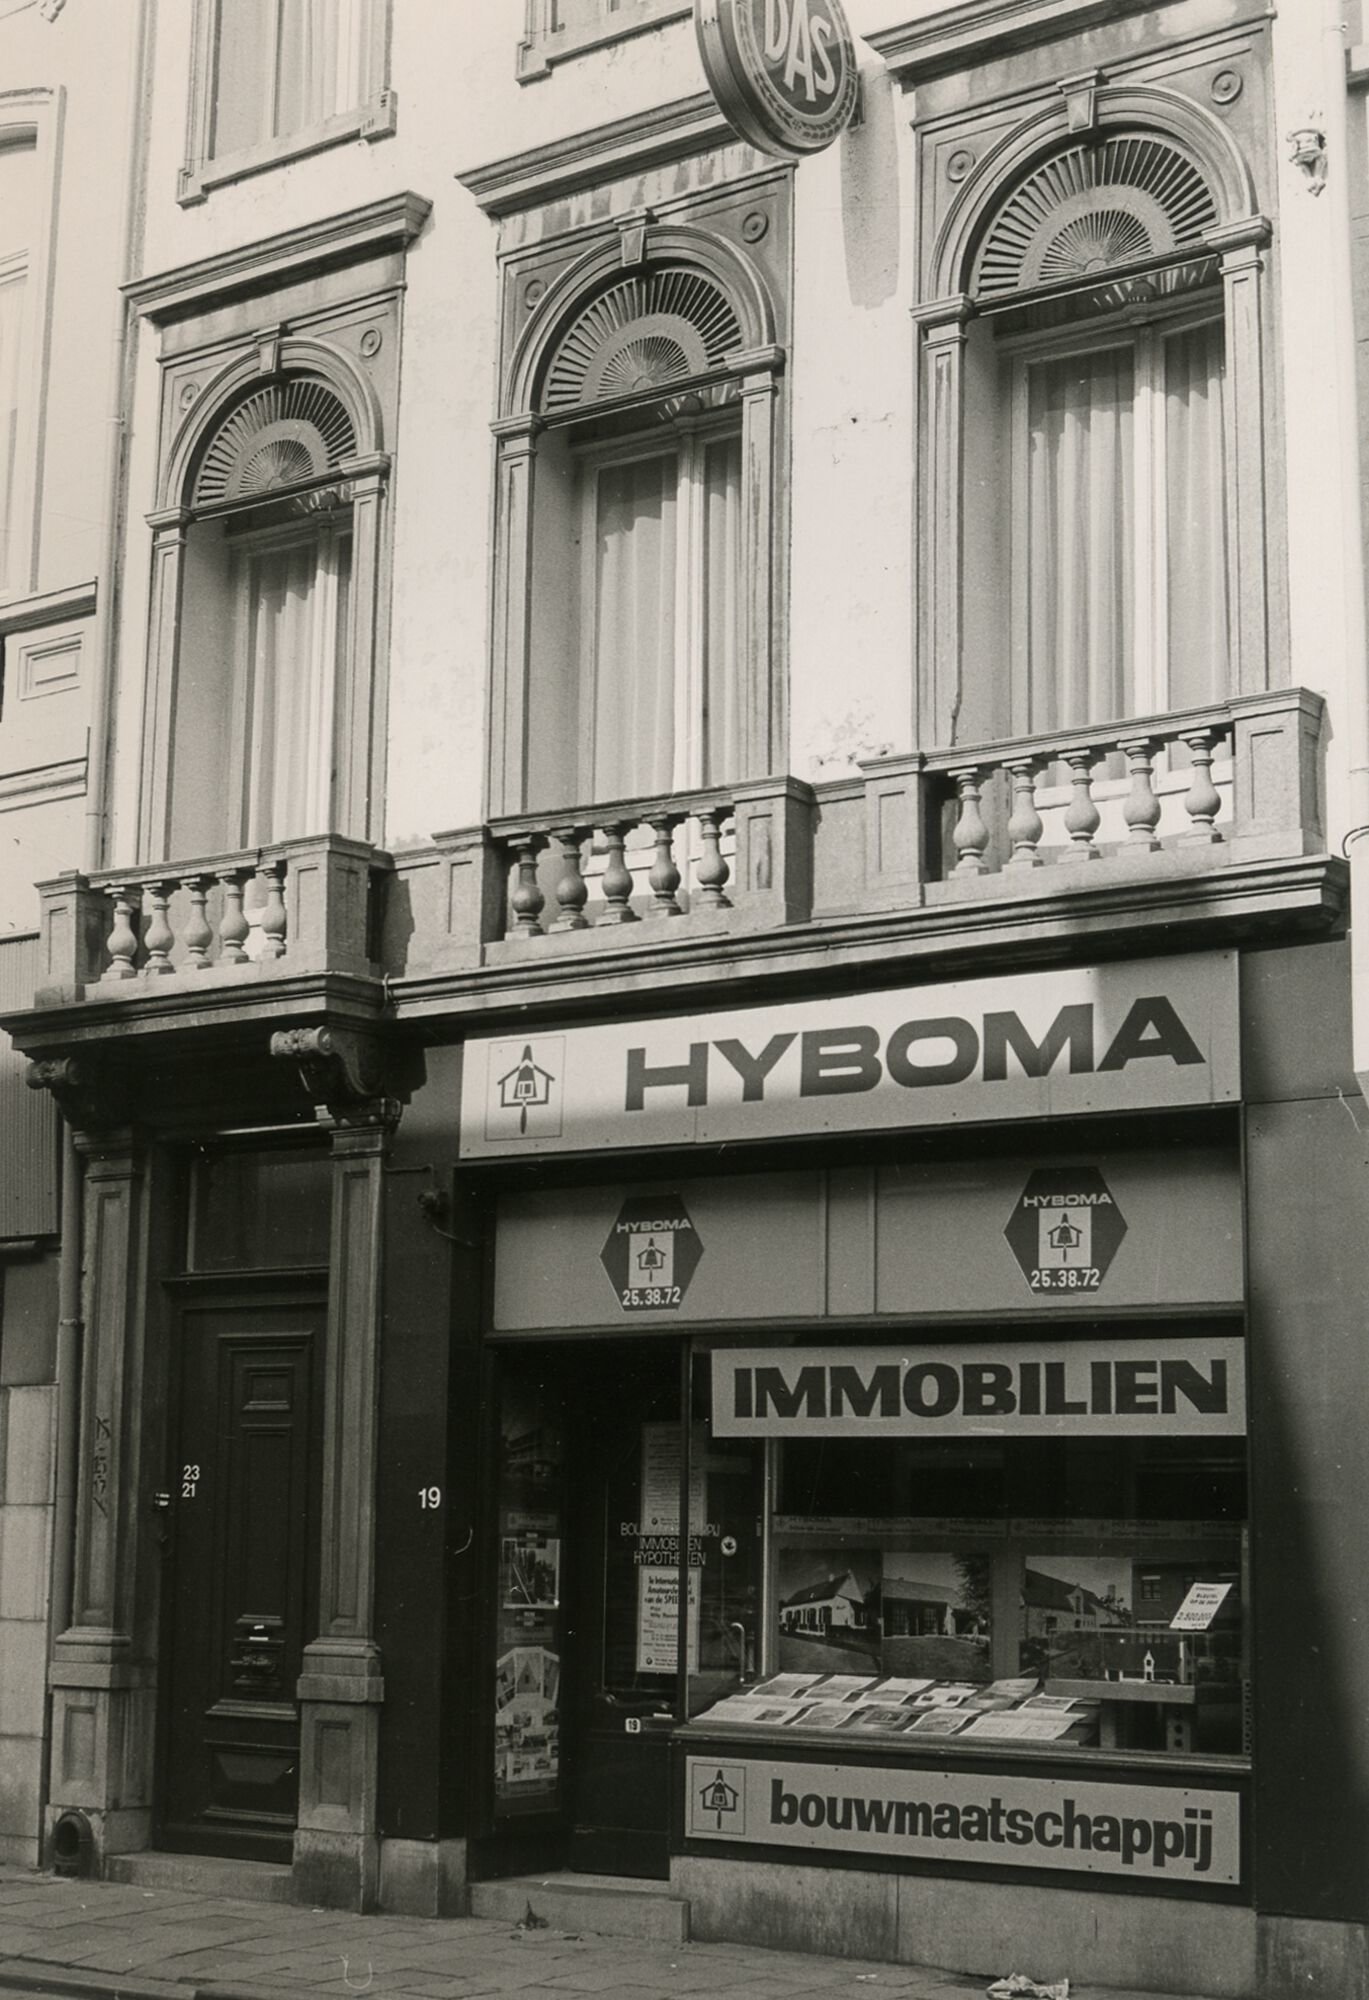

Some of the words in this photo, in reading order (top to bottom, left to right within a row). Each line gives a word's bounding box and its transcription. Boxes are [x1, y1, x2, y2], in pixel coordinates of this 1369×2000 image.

[625, 996, 1206, 1111] HYBOMA
[1023, 1193, 1113, 1208] HYBOMA
[616, 1217, 692, 1233] HYBOMA
[1031, 1269, 1100, 1288] 25.38.72
[622, 1286, 681, 1306] 25.38.72
[734, 1360, 1227, 1418] IMMOBILIEN
[183, 1465, 200, 1481] 23
[182, 1483, 196, 1498] 21
[418, 1487, 441, 1509] 19
[628, 1719, 638, 1731] 19
[771, 1779, 1213, 1872] bouwmaatschappij
